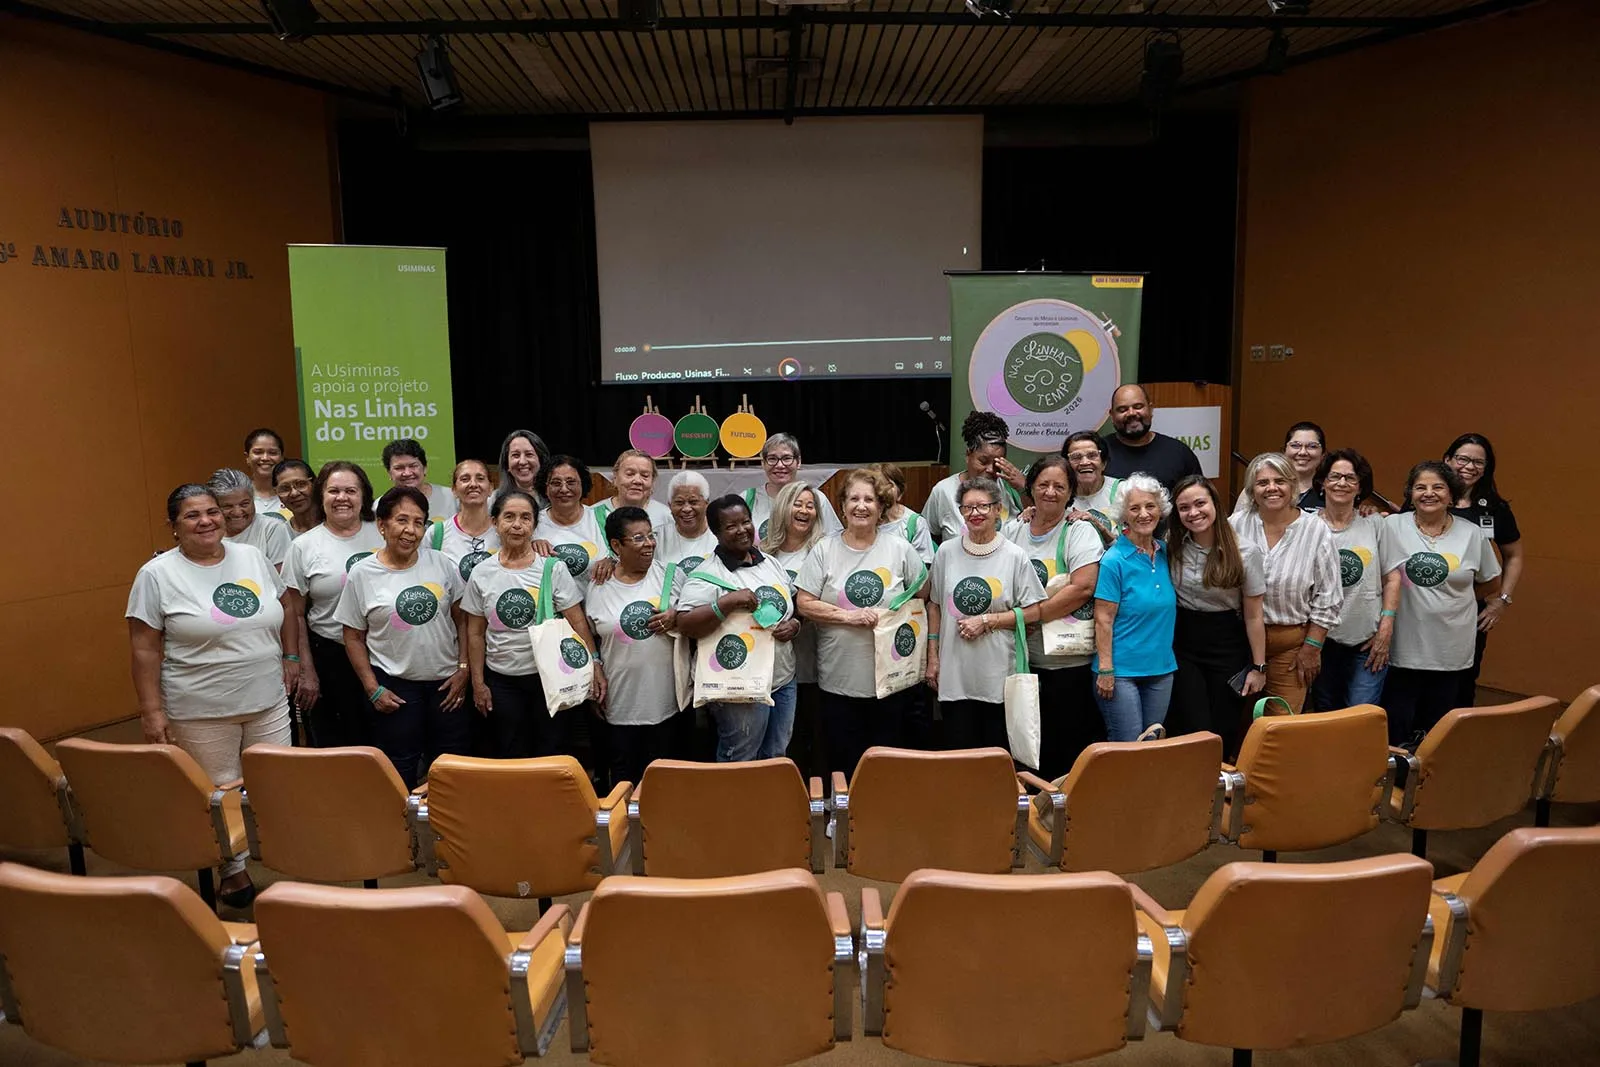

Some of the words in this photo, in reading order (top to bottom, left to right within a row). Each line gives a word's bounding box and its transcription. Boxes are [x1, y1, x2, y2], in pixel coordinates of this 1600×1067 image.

[57, 207, 184, 239] AUDITÓRIO
[32, 244, 120, 271] AMARO
[131, 251, 215, 278] LANARI
[225, 259, 254, 279] JR.
[397, 264, 436, 273] USIMINAS
[311, 364, 323, 377] A
[327, 363, 401, 378] Usiminas
[1008, 357, 1024, 379] NAS
[312, 379, 355, 397] apoia
[360, 382, 369, 393] o
[374, 379, 429, 397] projeto
[1036, 373, 1073, 407] TEMPO
[314, 399, 358, 418] Nas
[365, 397, 438, 418] Linhas
[316, 421, 346, 441] do
[350, 422, 429, 441] Tempo
[731, 431, 757, 439] FUTURO
